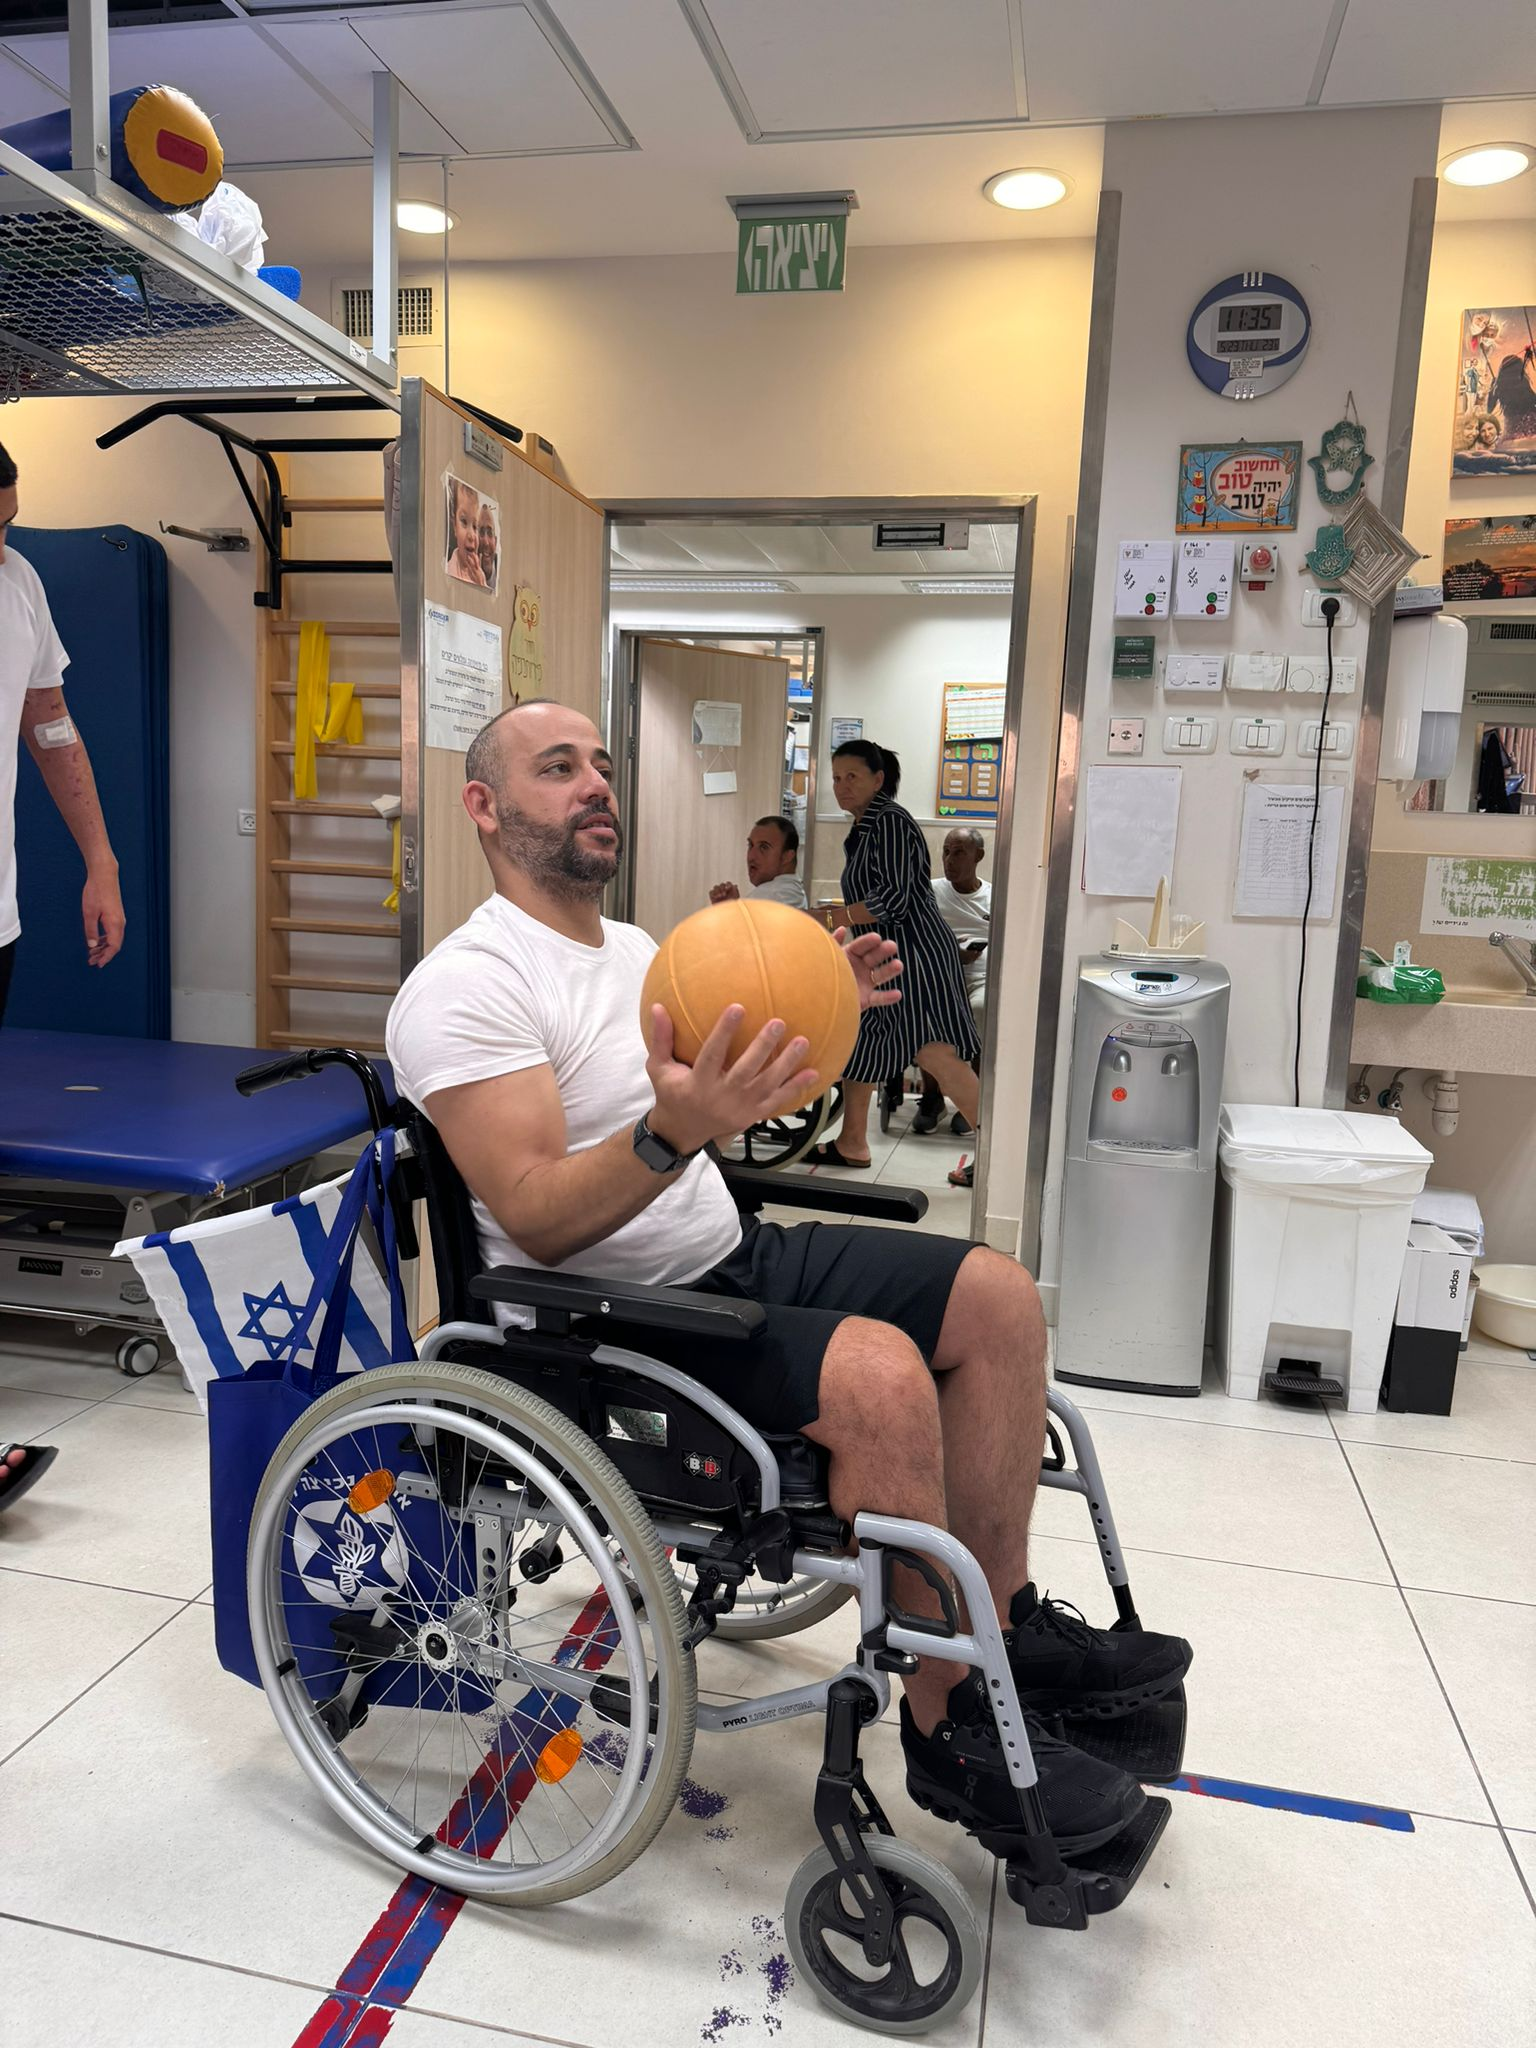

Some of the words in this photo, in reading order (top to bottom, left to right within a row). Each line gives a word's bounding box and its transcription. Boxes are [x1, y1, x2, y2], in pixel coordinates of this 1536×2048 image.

[753, 222, 829, 291] יציאה
[1226, 306, 1272, 331] 11:35
[1233, 459, 1280, 472] תחשוב
[1217, 472, 1253, 490] טוב
[1252, 480, 1282, 493] יהיה
[1230, 493, 1265, 510] טוב
[1449, 1269, 1460, 1299] adidas
[722, 1716, 748, 1729] PYRO
[748, 1708, 777, 1722] LIGHT
